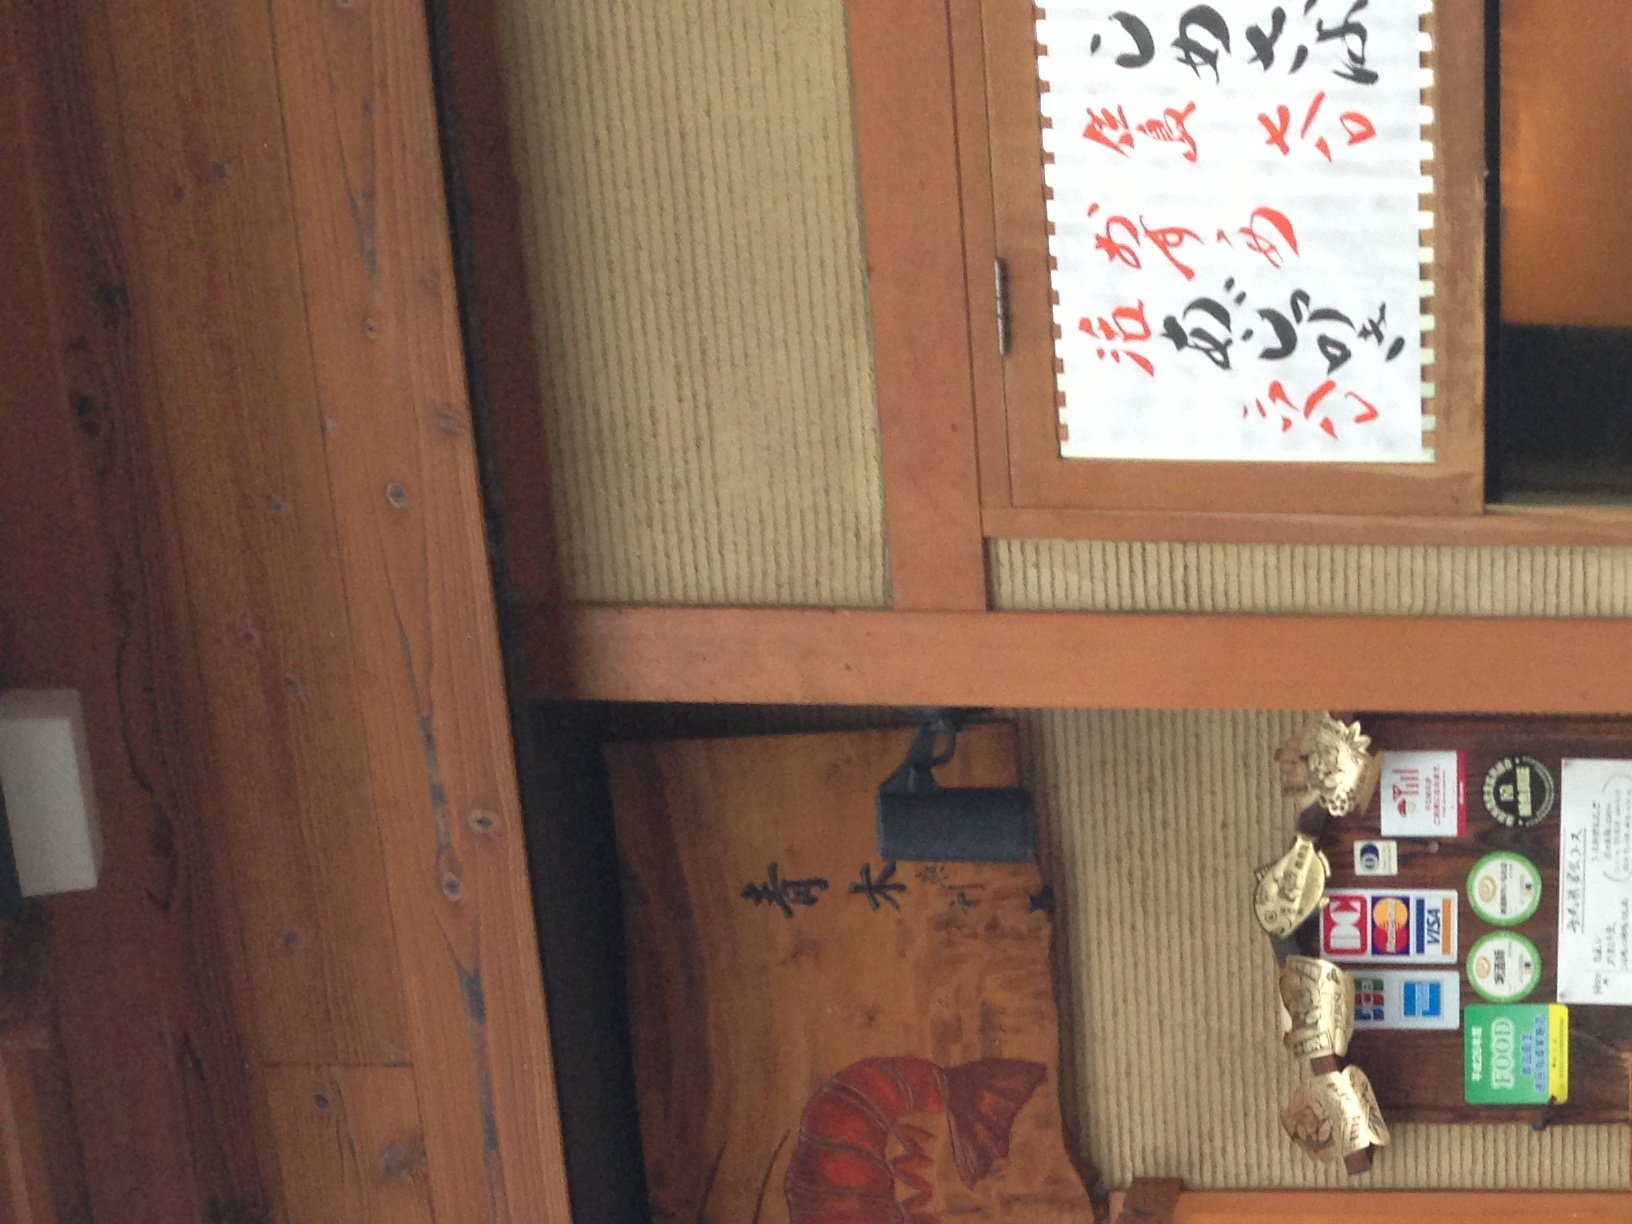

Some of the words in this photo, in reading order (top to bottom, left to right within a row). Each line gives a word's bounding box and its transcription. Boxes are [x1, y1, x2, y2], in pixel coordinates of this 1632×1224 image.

[740, 860, 906, 918] 青木
[1329, 900, 1361, 949] DC
[1426, 908, 1440, 945] VISA
[1493, 1020, 1512, 1086] FOOD
